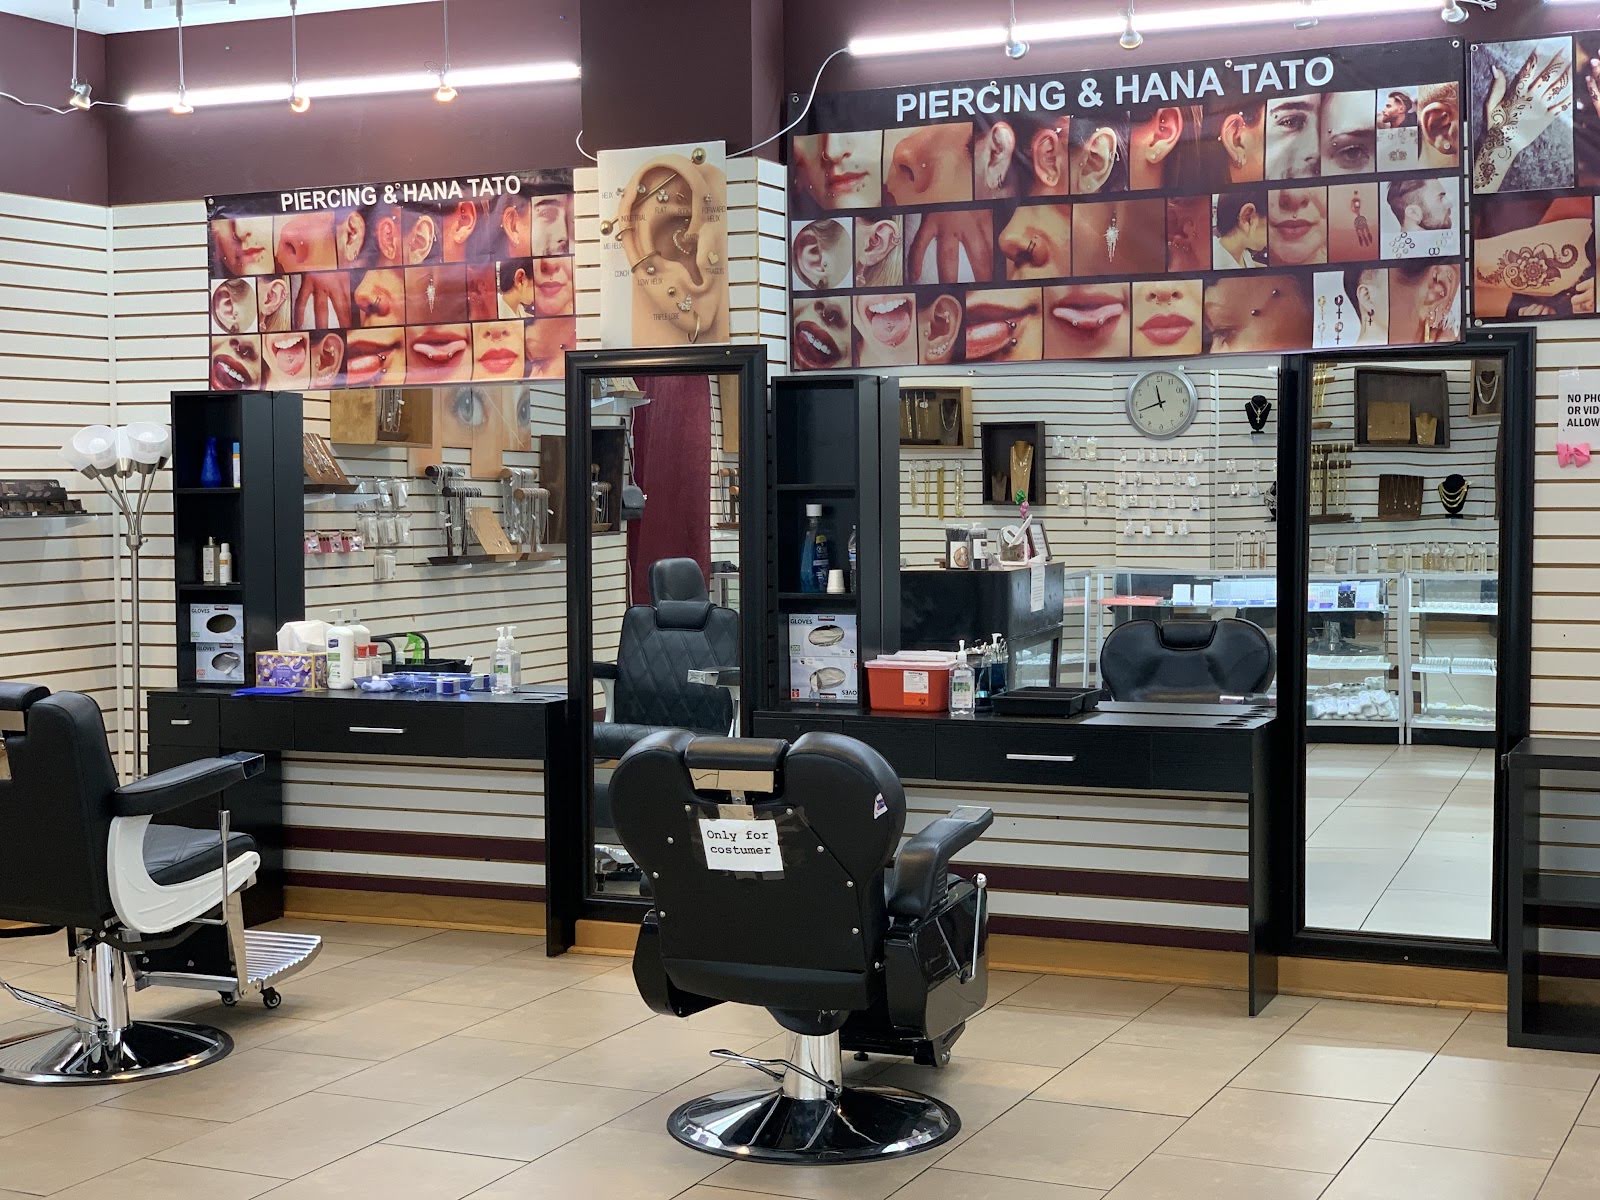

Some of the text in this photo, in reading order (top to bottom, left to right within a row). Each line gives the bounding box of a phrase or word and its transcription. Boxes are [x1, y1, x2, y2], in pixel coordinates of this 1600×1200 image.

[896, 56, 1335, 121] PIERCING & HANA TATO
[281, 175, 521, 212] PIERCING & HANA TATO
[655, 206, 667, 214] FLAT
[702, 205, 726, 214] FORWARD
[707, 214, 721, 222] HELIX
[1568, 394, 1581, 402] NO
[1567, 406, 1581, 415] OR
[707, 830, 768, 842] Only for
[710, 846, 771, 854] costumer
